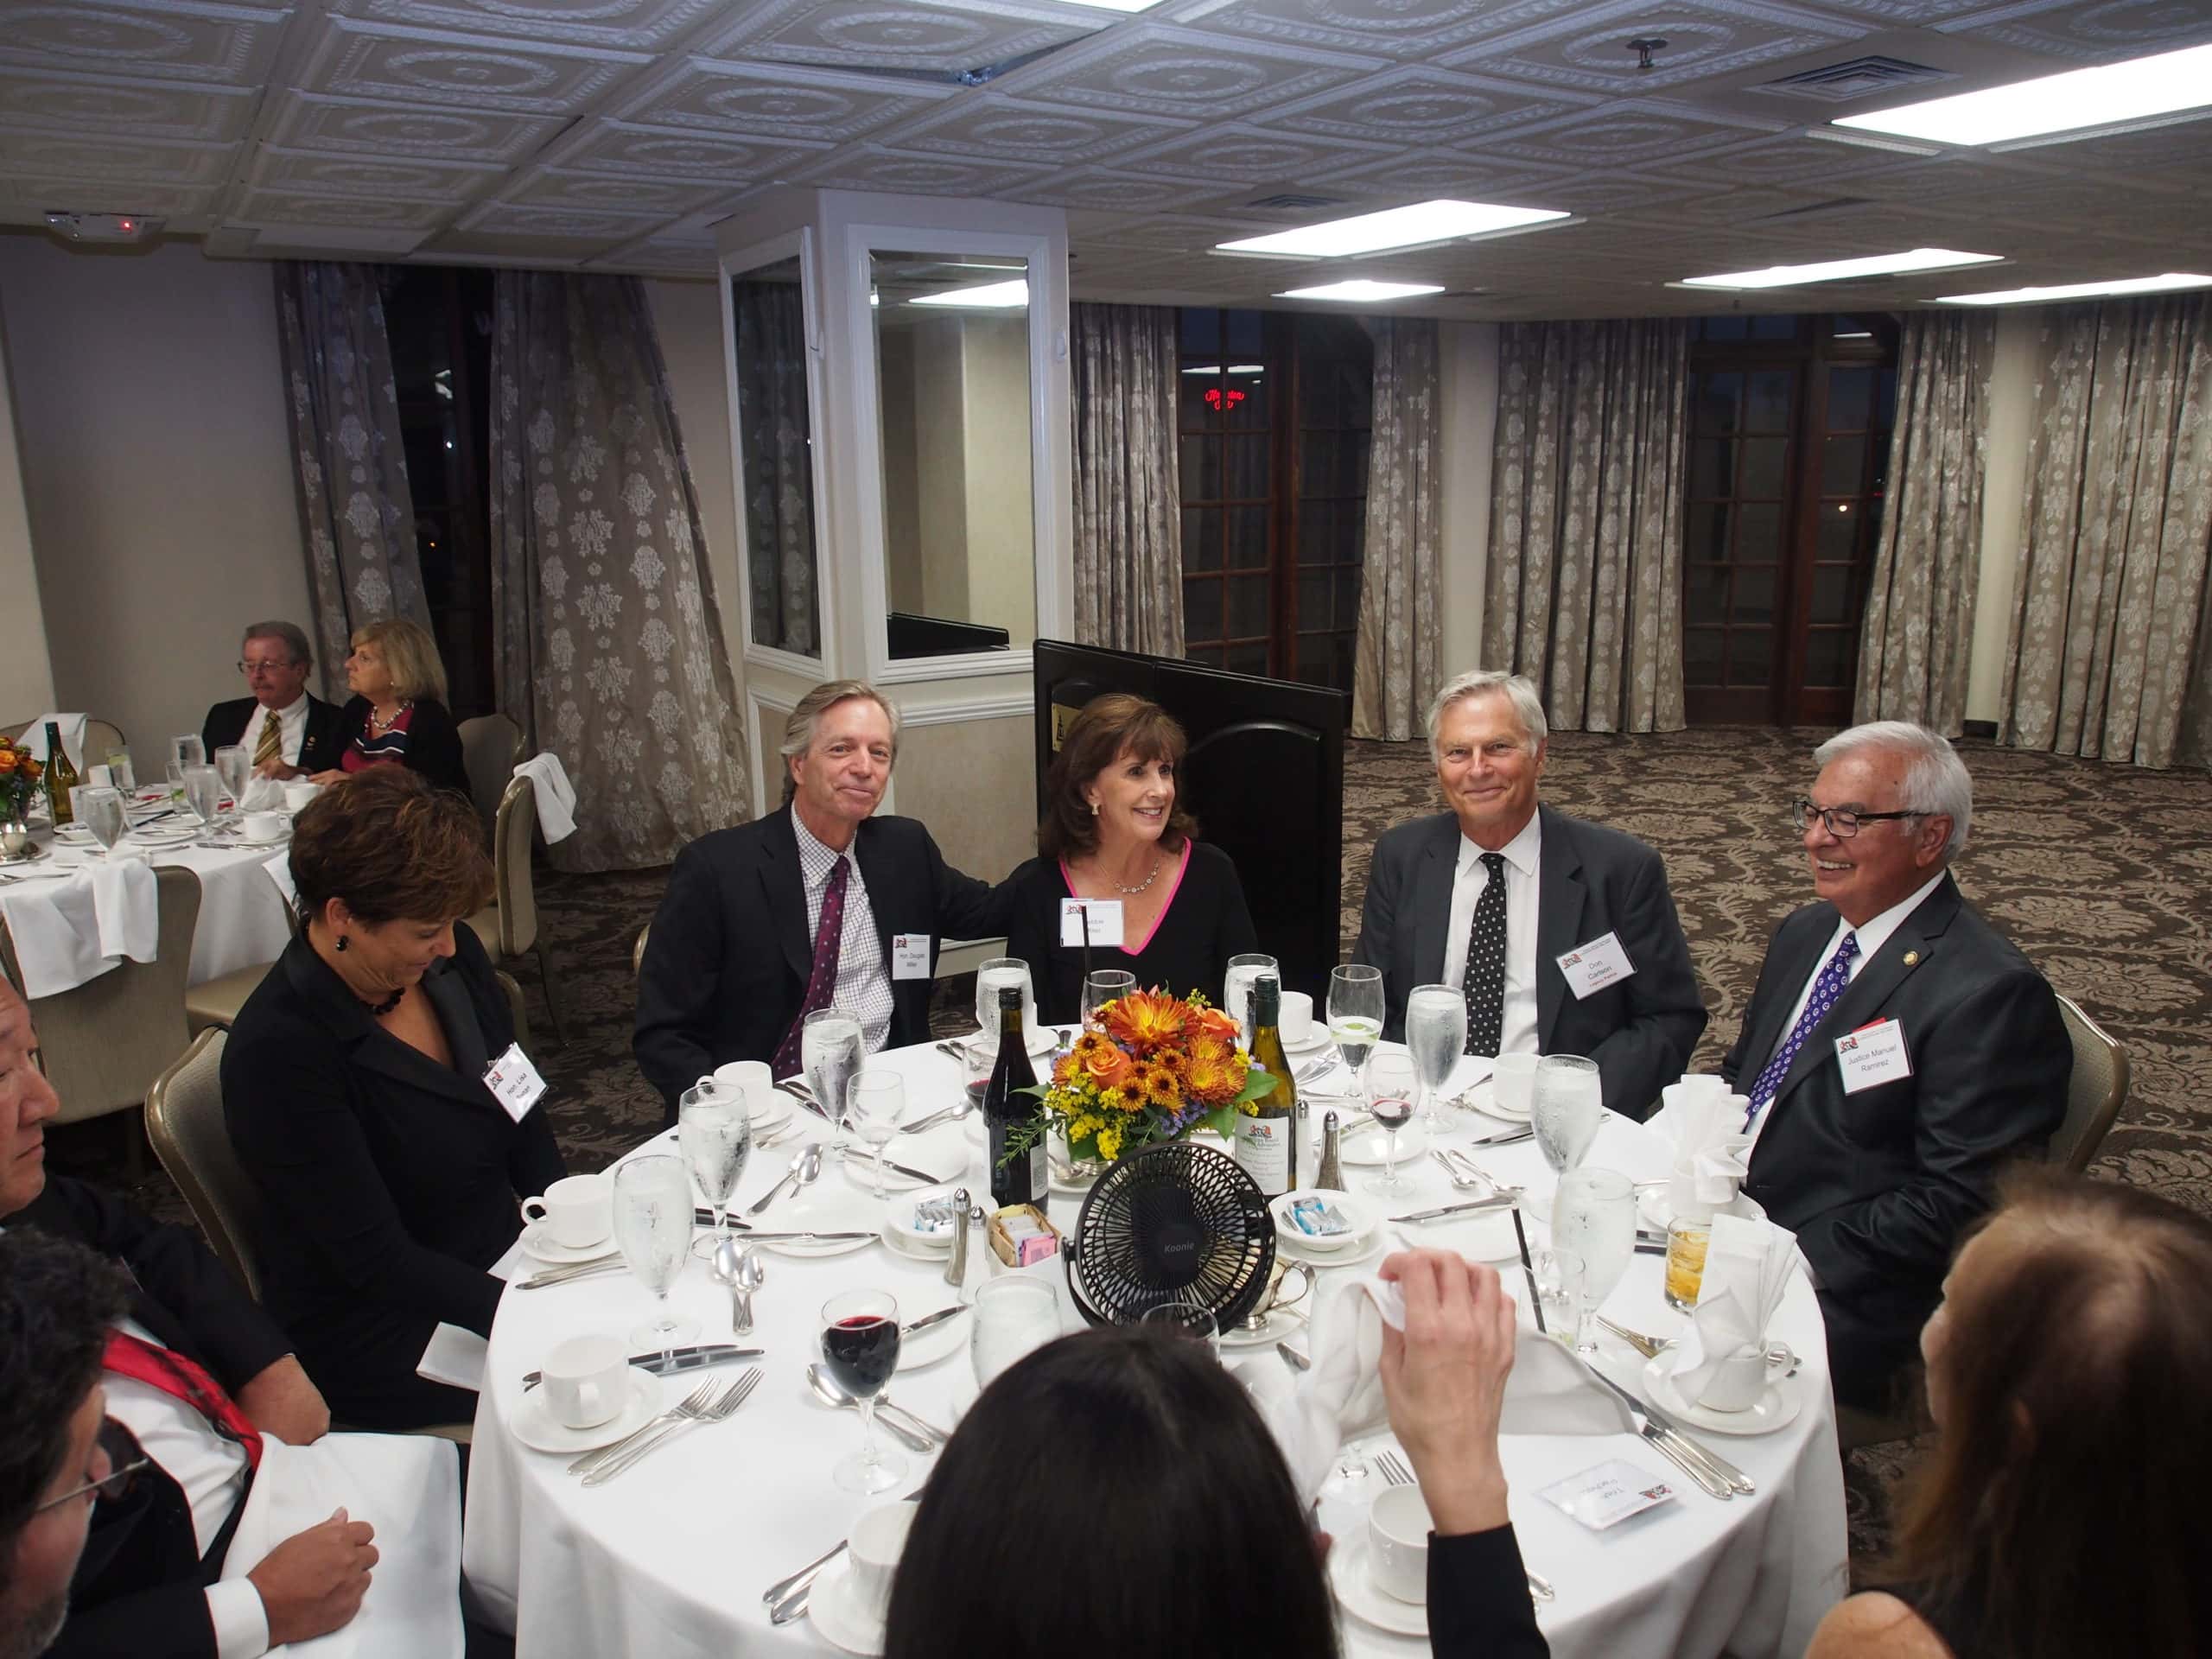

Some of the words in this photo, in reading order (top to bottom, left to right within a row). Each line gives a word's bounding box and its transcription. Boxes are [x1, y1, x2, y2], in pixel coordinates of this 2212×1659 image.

[1588, 960, 1603, 969] Don
[1588, 966, 1612, 980] Carlson
[1847, 1053, 1870, 1065] Justice
[1871, 1044, 1897, 1058] Manuel
[1860, 1058, 1890, 1071] Ramirez
[516, 1072, 527, 1084] Lisa
[1164, 1238, 1195, 1252] Koonie
